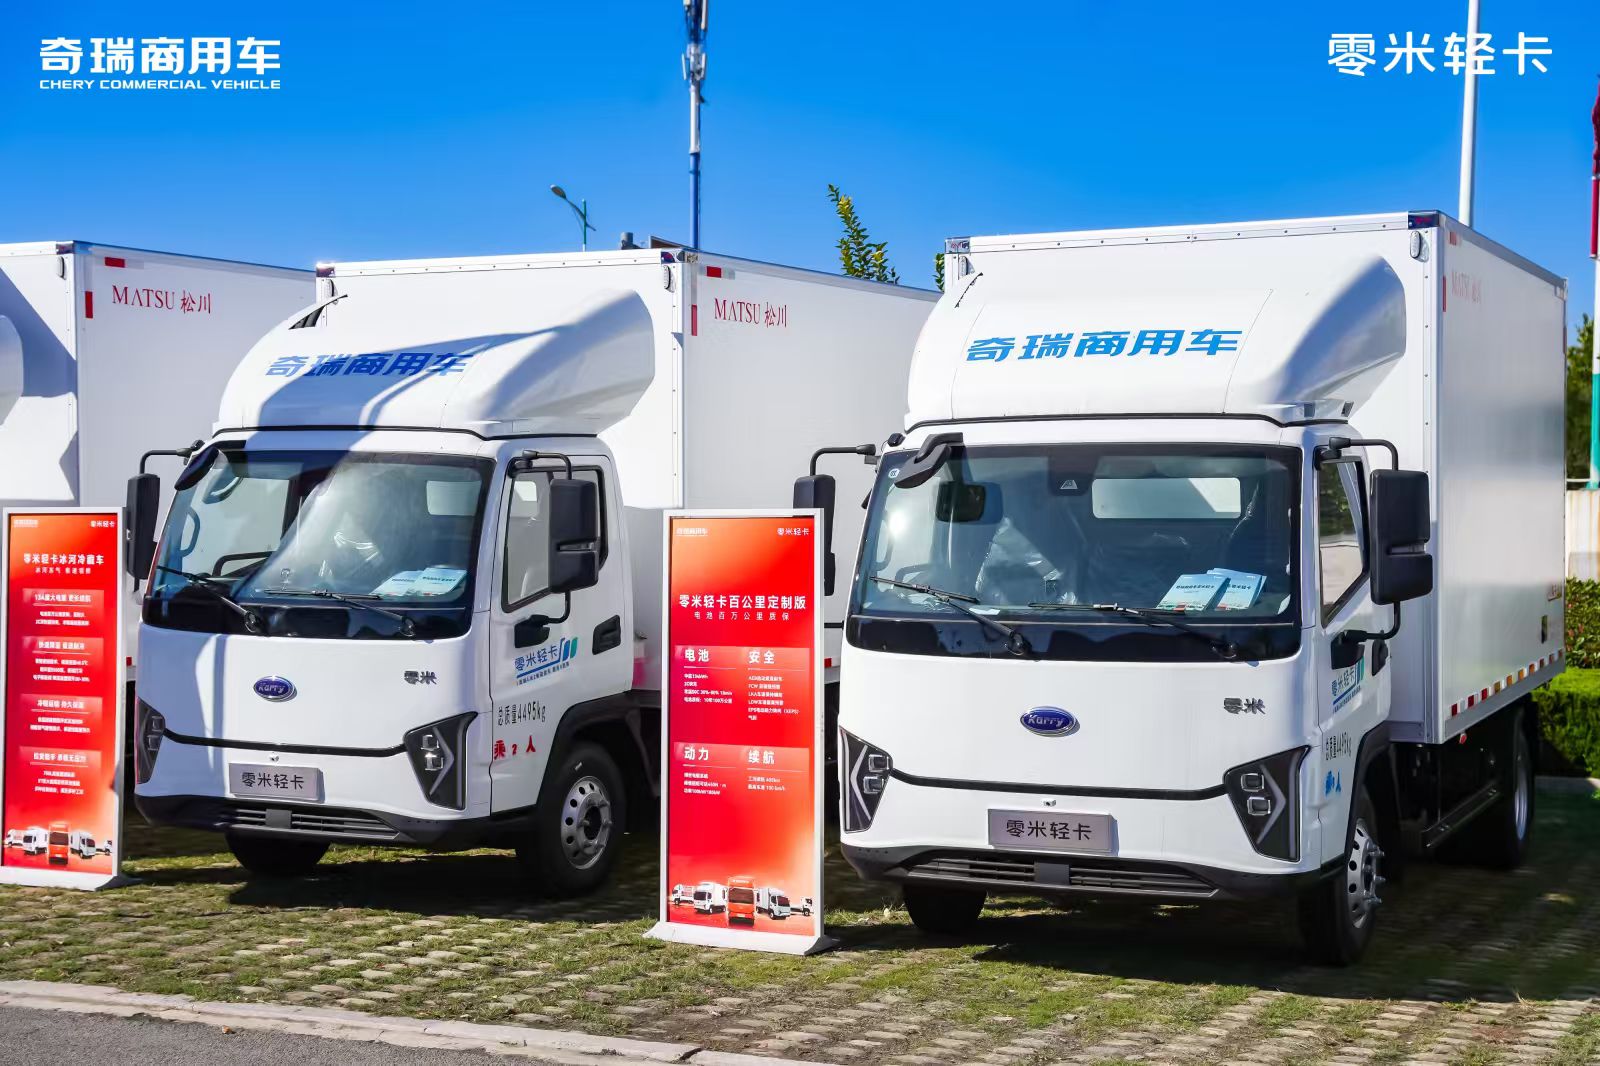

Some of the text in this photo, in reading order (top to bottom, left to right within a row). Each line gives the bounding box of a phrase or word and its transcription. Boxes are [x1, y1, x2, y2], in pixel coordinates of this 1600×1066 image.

[112, 284, 212, 314] MATSU 松川
[714, 297, 787, 329] MATSU 松川
[966, 328, 1243, 362] 奇瑞商用车
[265, 352, 474, 377] 奇瑞商用车
[777, 527, 810, 536] 零米轻卡
[679, 594, 807, 609] 零米轻卡百公里定制版
[514, 645, 558, 672] 零米轻卡
[684, 648, 709, 662] 电池
[748, 650, 775, 664] 安全
[1027, 713, 1067, 728] Karry
[684, 746, 709, 761] 动力
[748, 749, 775, 765] 续航
[241, 771, 305, 790] 零米轻卡
[1005, 819, 1093, 841] 零米轻卡
